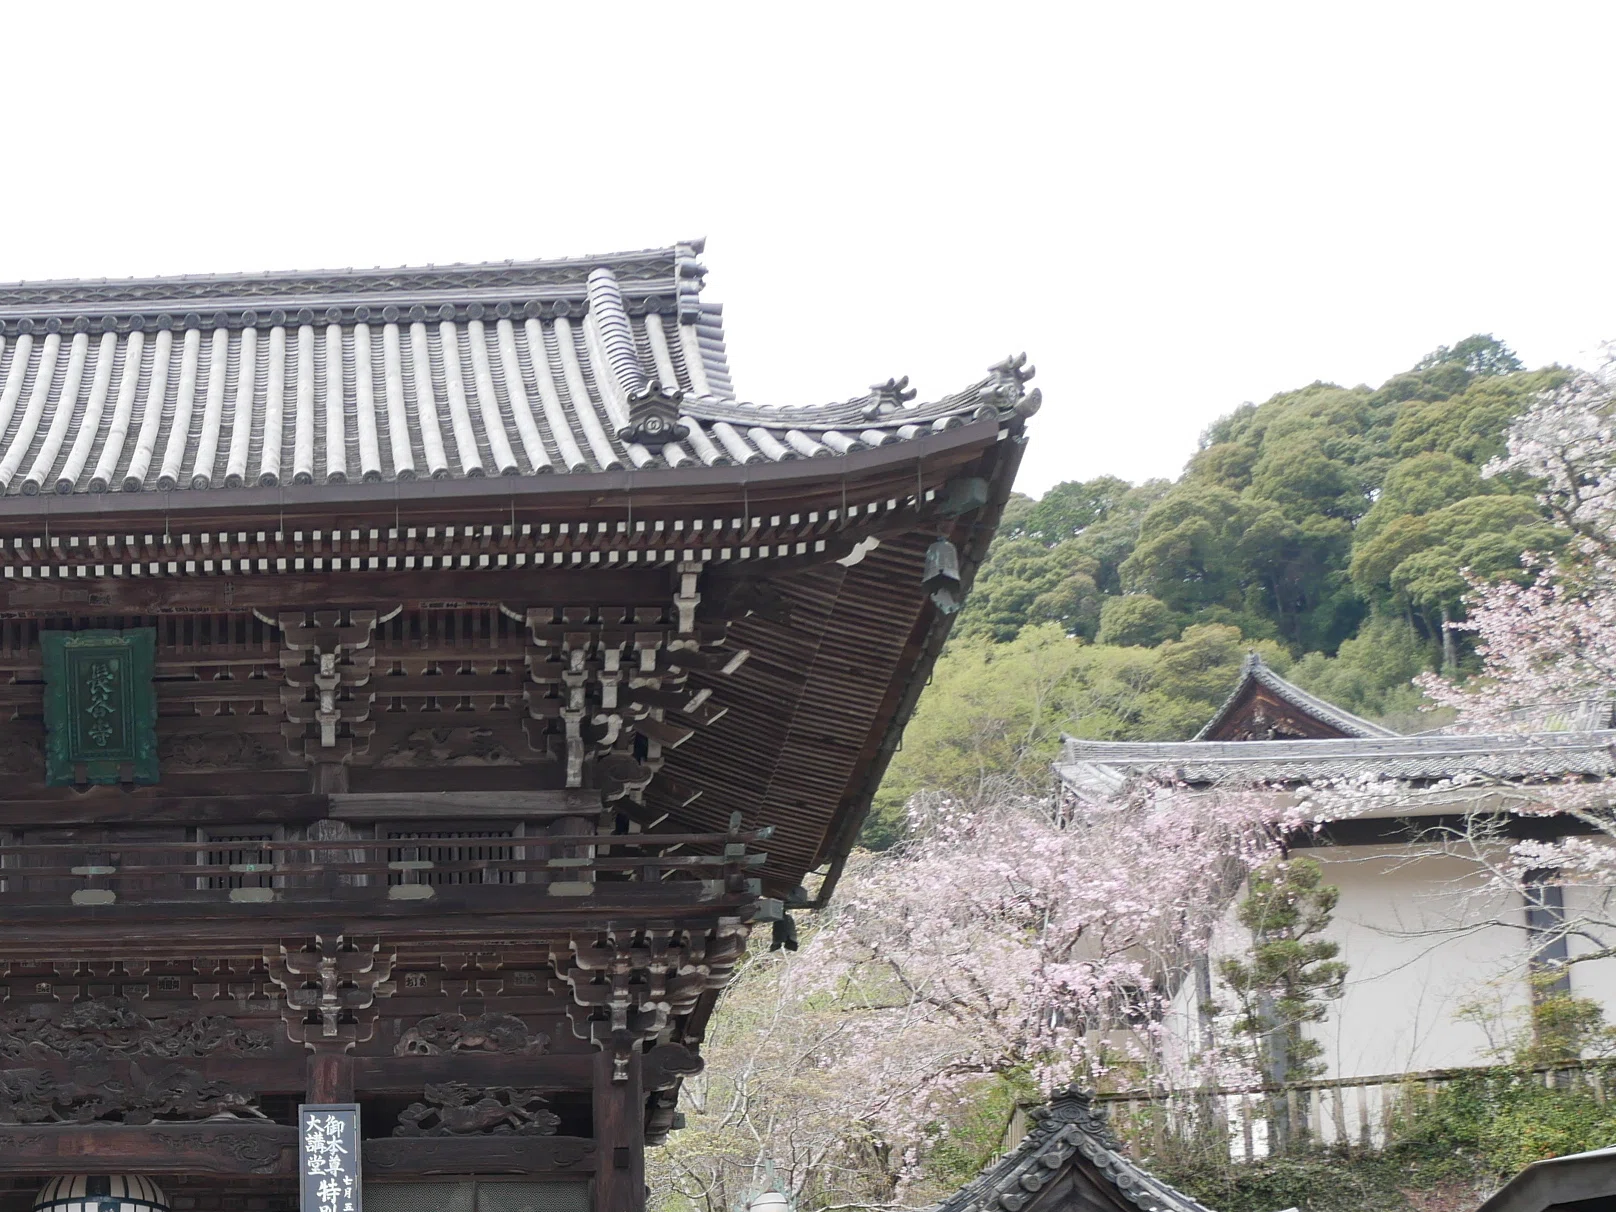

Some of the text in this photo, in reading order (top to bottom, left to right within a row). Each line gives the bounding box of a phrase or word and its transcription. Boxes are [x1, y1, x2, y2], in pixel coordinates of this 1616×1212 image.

[86, 664, 116, 747] 長谷寺
[304, 1114, 328, 1177] 大講堂
[323, 1114, 348, 1178] 御本尊
